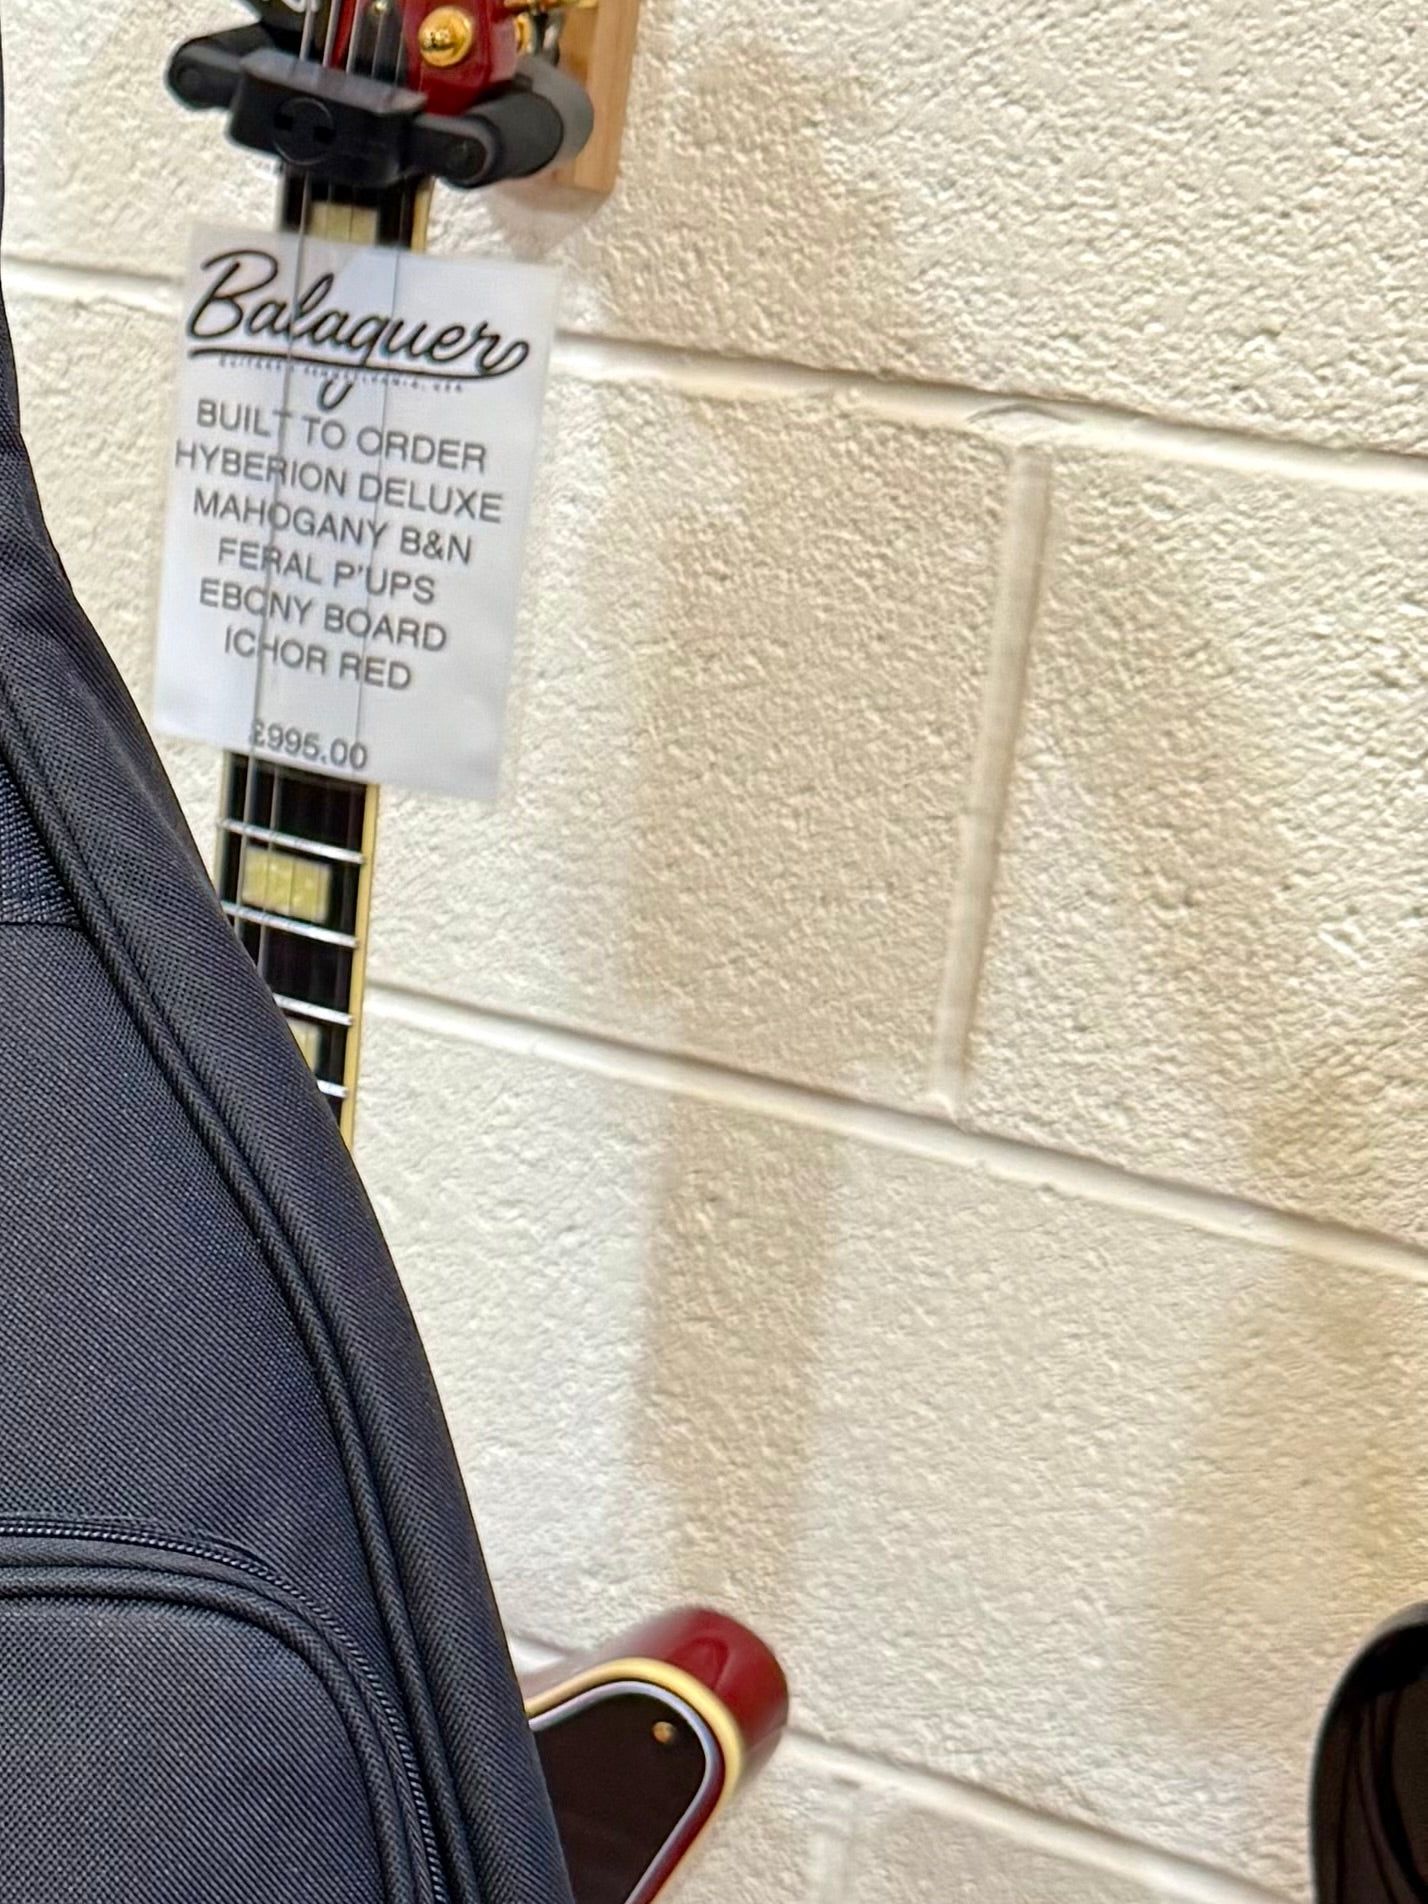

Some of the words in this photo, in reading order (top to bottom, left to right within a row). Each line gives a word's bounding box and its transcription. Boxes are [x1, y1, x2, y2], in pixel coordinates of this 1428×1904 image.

[187, 248, 530, 411] Balaguer
[196, 398, 289, 441] BUILT
[301, 415, 347, 450] TO
[357, 427, 485, 474] ORDER
[175, 441, 348, 497] HYBERION
[359, 476, 503, 524] DELUXE
[193, 491, 388, 549] MAHOGANY
[400, 529, 472, 566] B&N
[218, 537, 322, 584] FERAL
[333, 562, 435, 604] P'UPS
[200, 580, 312, 625] EBONY
[324, 607, 448, 651] BOARD
[225, 626, 327, 672] ICHOR
[339, 653, 413, 691] RED
[249, 718, 368, 771] £995.00
